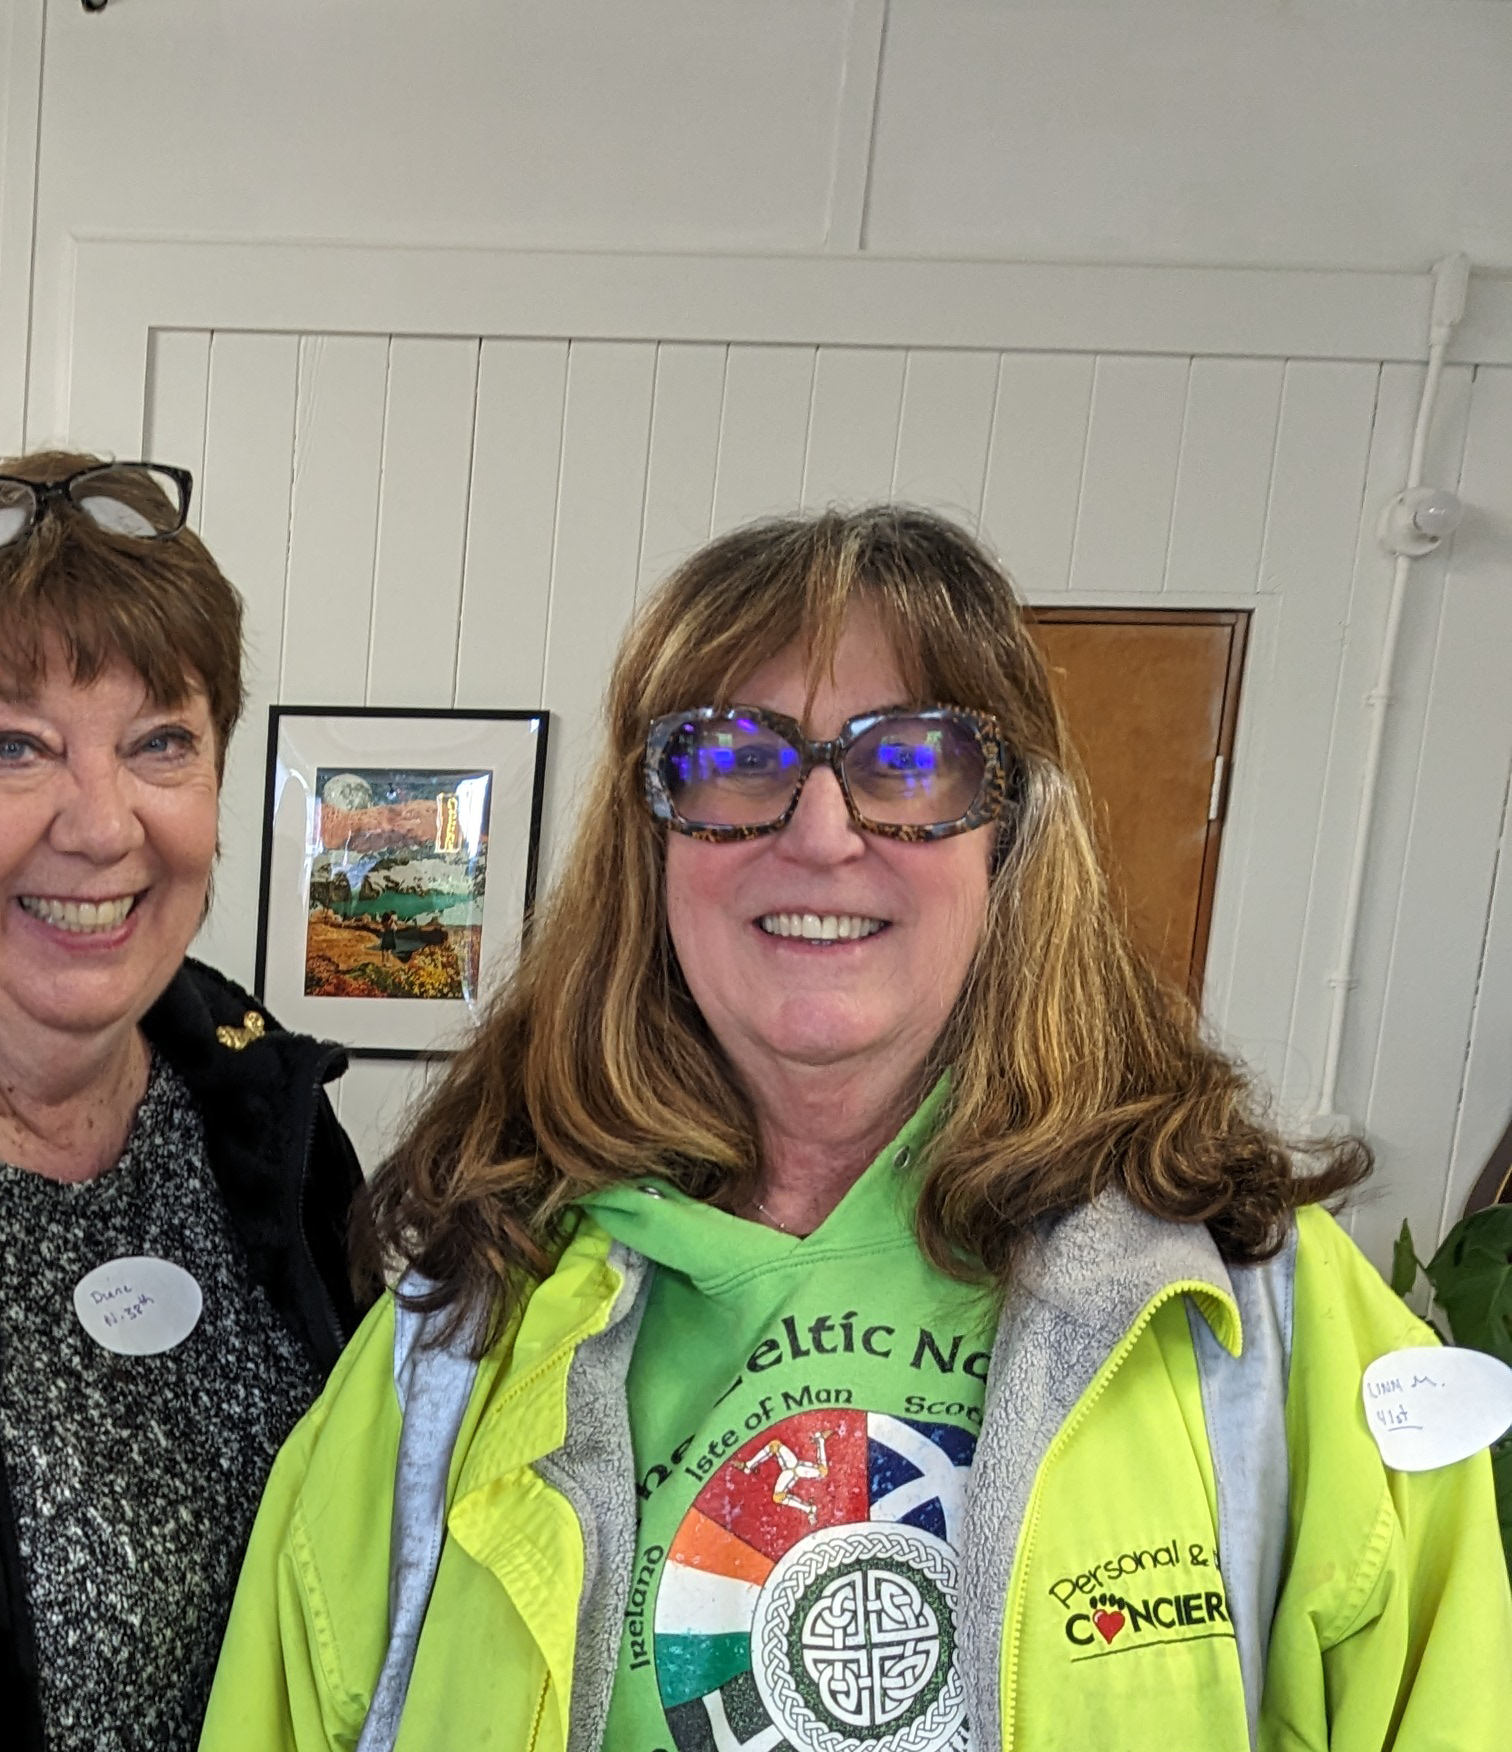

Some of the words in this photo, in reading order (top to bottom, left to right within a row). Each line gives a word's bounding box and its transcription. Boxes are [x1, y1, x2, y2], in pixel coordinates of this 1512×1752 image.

[745, 1395, 777, 1431] of
[781, 1384, 853, 1411] Man
[624, 1544, 665, 1671] Ireland
[1048, 1539, 1181, 1610] Personal
[1188, 1543, 1210, 1567] &
